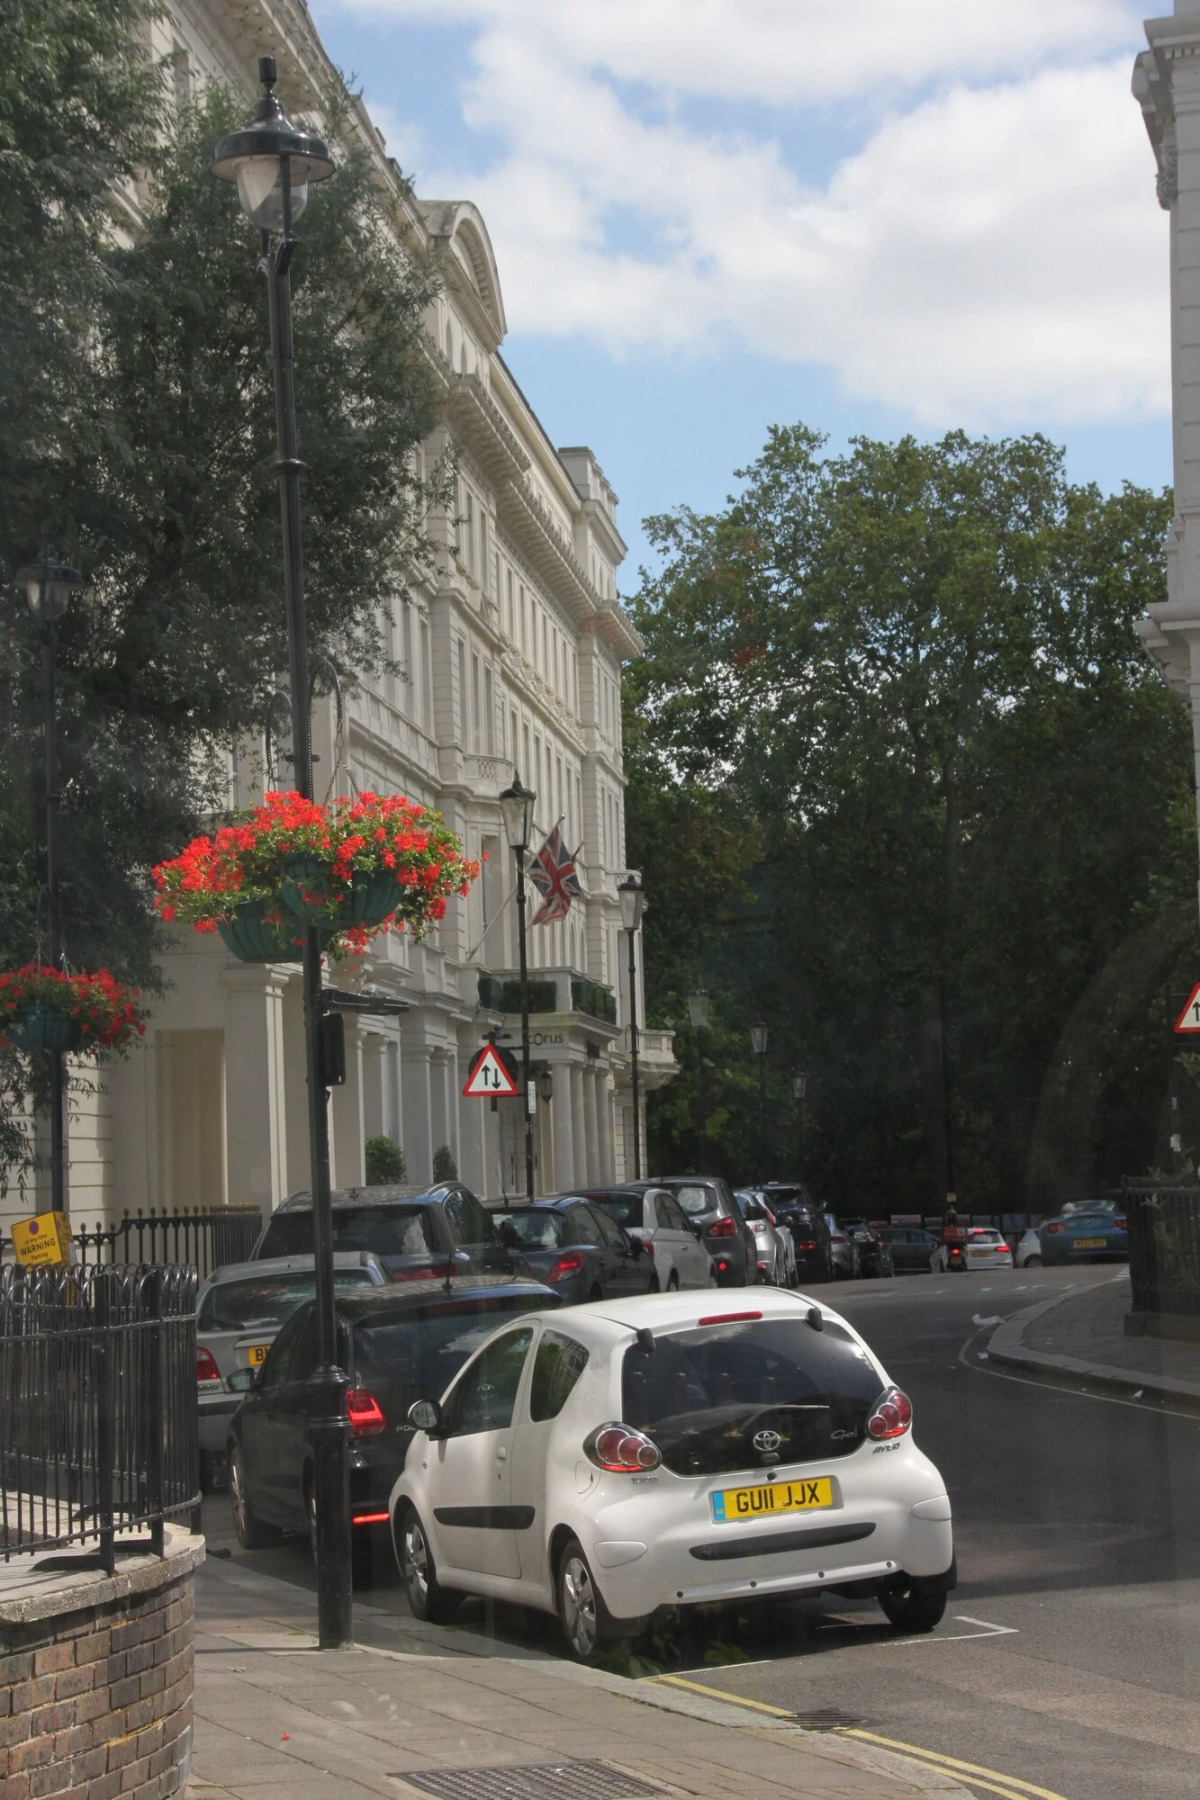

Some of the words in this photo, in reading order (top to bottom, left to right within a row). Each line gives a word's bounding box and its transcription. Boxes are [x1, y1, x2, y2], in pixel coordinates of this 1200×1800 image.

[20, 1238, 56, 1256] WARNING
[31, 1252, 48, 1260] Parking
[781, 1482, 820, 1507] JJX
